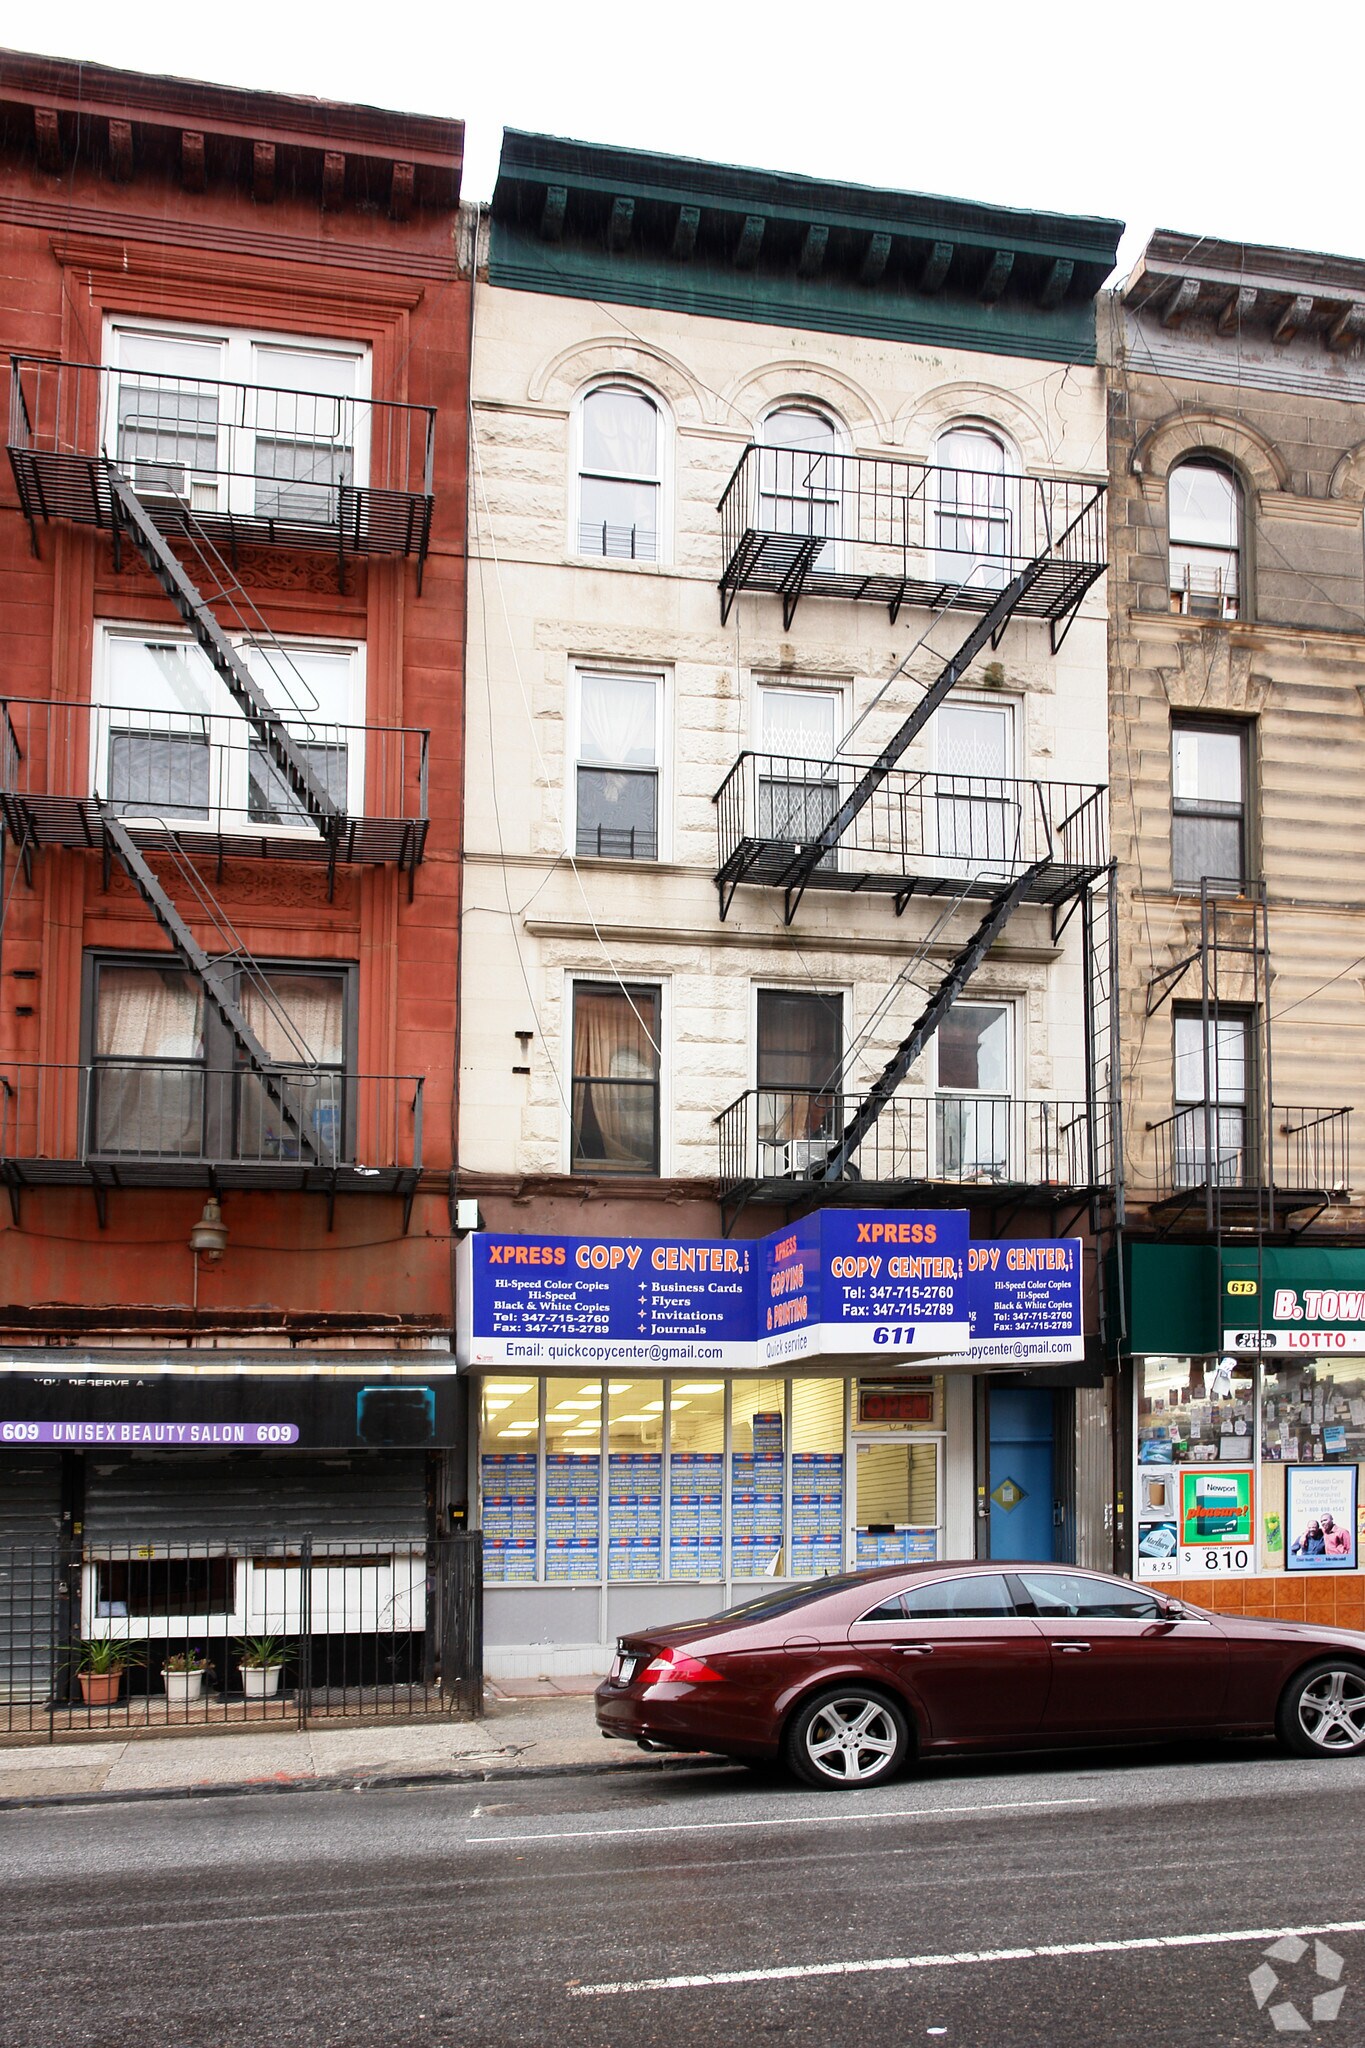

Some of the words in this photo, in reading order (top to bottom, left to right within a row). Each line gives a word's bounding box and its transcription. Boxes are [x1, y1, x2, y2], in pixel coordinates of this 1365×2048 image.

[857, 1223, 937, 1243] XPRESS
[774, 1235, 797, 1262] XPRESS
[489, 1245, 566, 1265] XPRESS
[575, 1245, 642, 1271] COPY
[651, 1246, 743, 1274] CENTER,
[968, 1247, 1001, 1271] OPY
[1006, 1247, 1069, 1272] CENTER,
[831, 1256, 882, 1279] COPY
[888, 1255, 957, 1280] CENTER,
[495, 1279, 541, 1290] Hi-Speed
[544, 1280, 572, 1289] Color
[574, 1281, 609, 1292] Copies
[771, 1263, 804, 1298] COPYING
[995, 1281, 1026, 1291] Hi-Speed
[1027, 1281, 1047, 1290] Color
[1048, 1280, 1072, 1291] Copies
[651, 1282, 705, 1293] Business
[708, 1282, 743, 1293] Cards
[842, 1286, 866, 1298] Tel:
[869, 1286, 953, 1298] 347-715-2760
[1231, 1283, 1254, 1293] 613
[528, 1291, 576, 1302] Hi-Speed
[651, 1295, 691, 1307] Flyers
[1017, 1291, 1050, 1301] Hi-Speed
[494, 1301, 524, 1311] Black
[526, 1302, 537, 1310] &
[540, 1302, 572, 1311] White
[574, 1303, 610, 1313] Copies
[842, 1304, 869, 1316] Fax:
[873, 1304, 954, 1316] 347-715-2789
[994, 1302, 1014, 1310] Black
[1015, 1301, 1024, 1310] &
[1024, 1301, 1047, 1310] White
[1048, 1301, 1072, 1311] Copies
[1273, 1289, 1365, 1321] B.TOW
[493, 1313, 517, 1322] Tel:
[522, 1314, 610, 1323] 347-715-2760
[651, 1307, 724, 1321] Invitations
[766, 1307, 773, 1331] &
[774, 1295, 808, 1329] PRINTING
[994, 1312, 1010, 1321] Tel:
[1012, 1312, 1072, 1321] 347-715-2760
[493, 1324, 521, 1332] Fax:
[525, 1324, 610, 1334] 347-715-2789
[651, 1324, 707, 1335] Journals
[994, 1323, 1013, 1331] Fax:
[1015, 1322, 1073, 1331] 347-715-2789
[873, 1327, 916, 1344] 611
[1289, 1332, 1346, 1348] LOTTO
[506, 1342, 544, 1356] Email:
[548, 1343, 723, 1361] quickcopycenter@gmail.com
[766, 1340, 783, 1359] Quick
[784, 1335, 808, 1355] service
[867, 1395, 928, 1418] OPEN
[2, 1423, 39, 1441] 609
[52, 1424, 116, 1441] UNISEX
[121, 1425, 186, 1441] BEAUTY
[190, 1425, 245, 1442] SALON
[256, 1426, 292, 1442] 609
[1207, 1484, 1236, 1492] Newport
[1186, 1504, 1249, 1520] pleasure!
[1146, 1536, 1170, 1550] Marlboro
[1184, 1552, 1192, 1562] $
[1205, 1550, 1248, 1570] 8.10
[1152, 1562, 1172, 1573] 8.25
